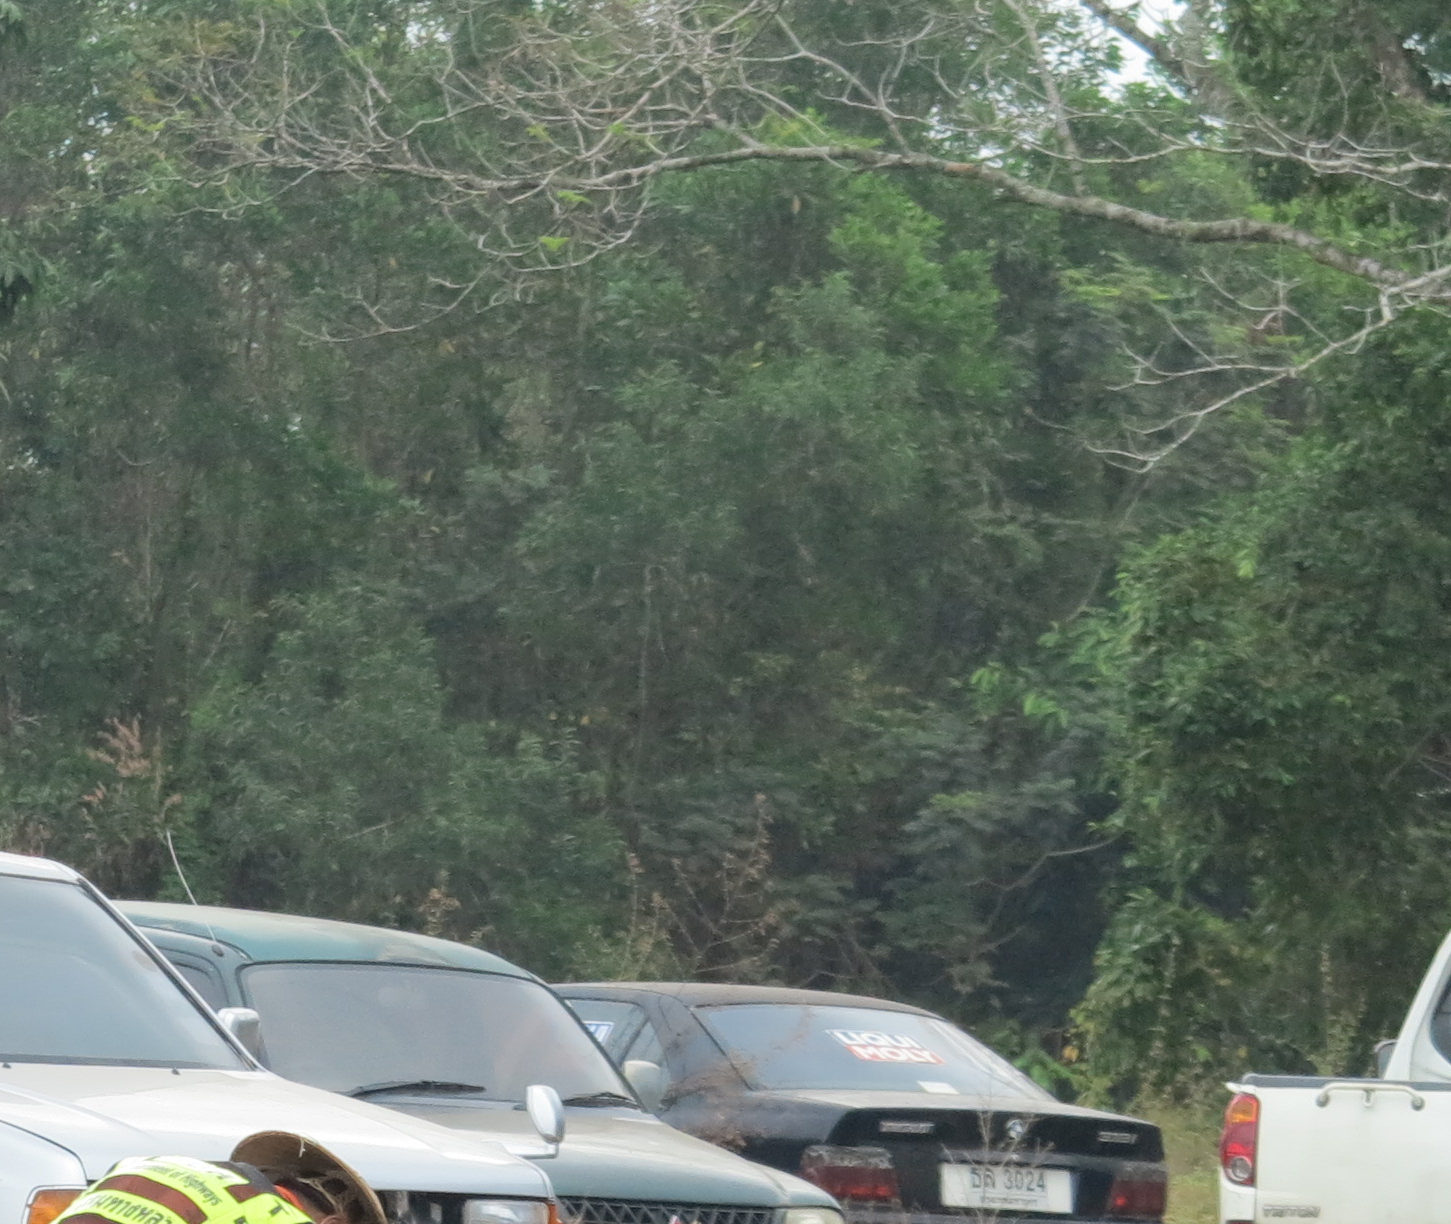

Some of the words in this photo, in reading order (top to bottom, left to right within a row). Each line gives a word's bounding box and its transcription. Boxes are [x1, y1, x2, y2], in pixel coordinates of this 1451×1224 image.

[833, 1031, 923, 1049] LIQUI
[852, 1046, 939, 1064] MOLY
[1004, 1168, 1046, 1192] 3024
